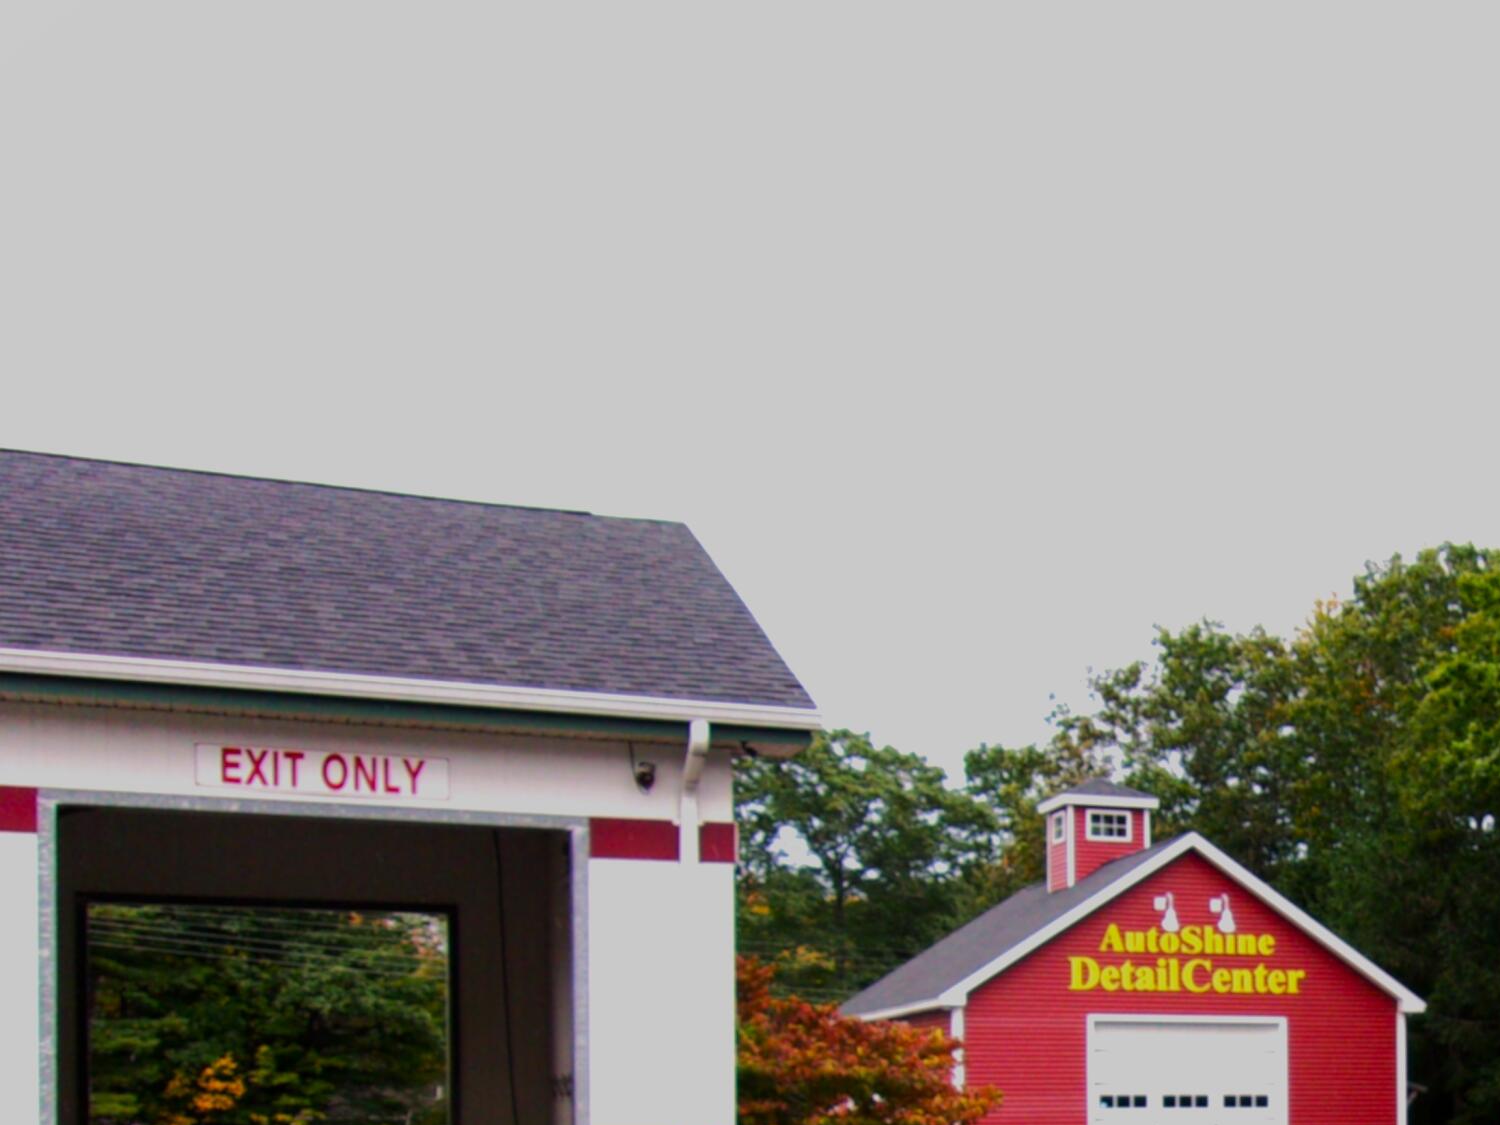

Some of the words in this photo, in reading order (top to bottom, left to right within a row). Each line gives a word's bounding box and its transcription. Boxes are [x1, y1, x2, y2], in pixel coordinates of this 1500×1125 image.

[220, 747, 304, 787] EXIT
[321, 753, 425, 794] ONLY
[1099, 923, 1275, 955] AutoShine
